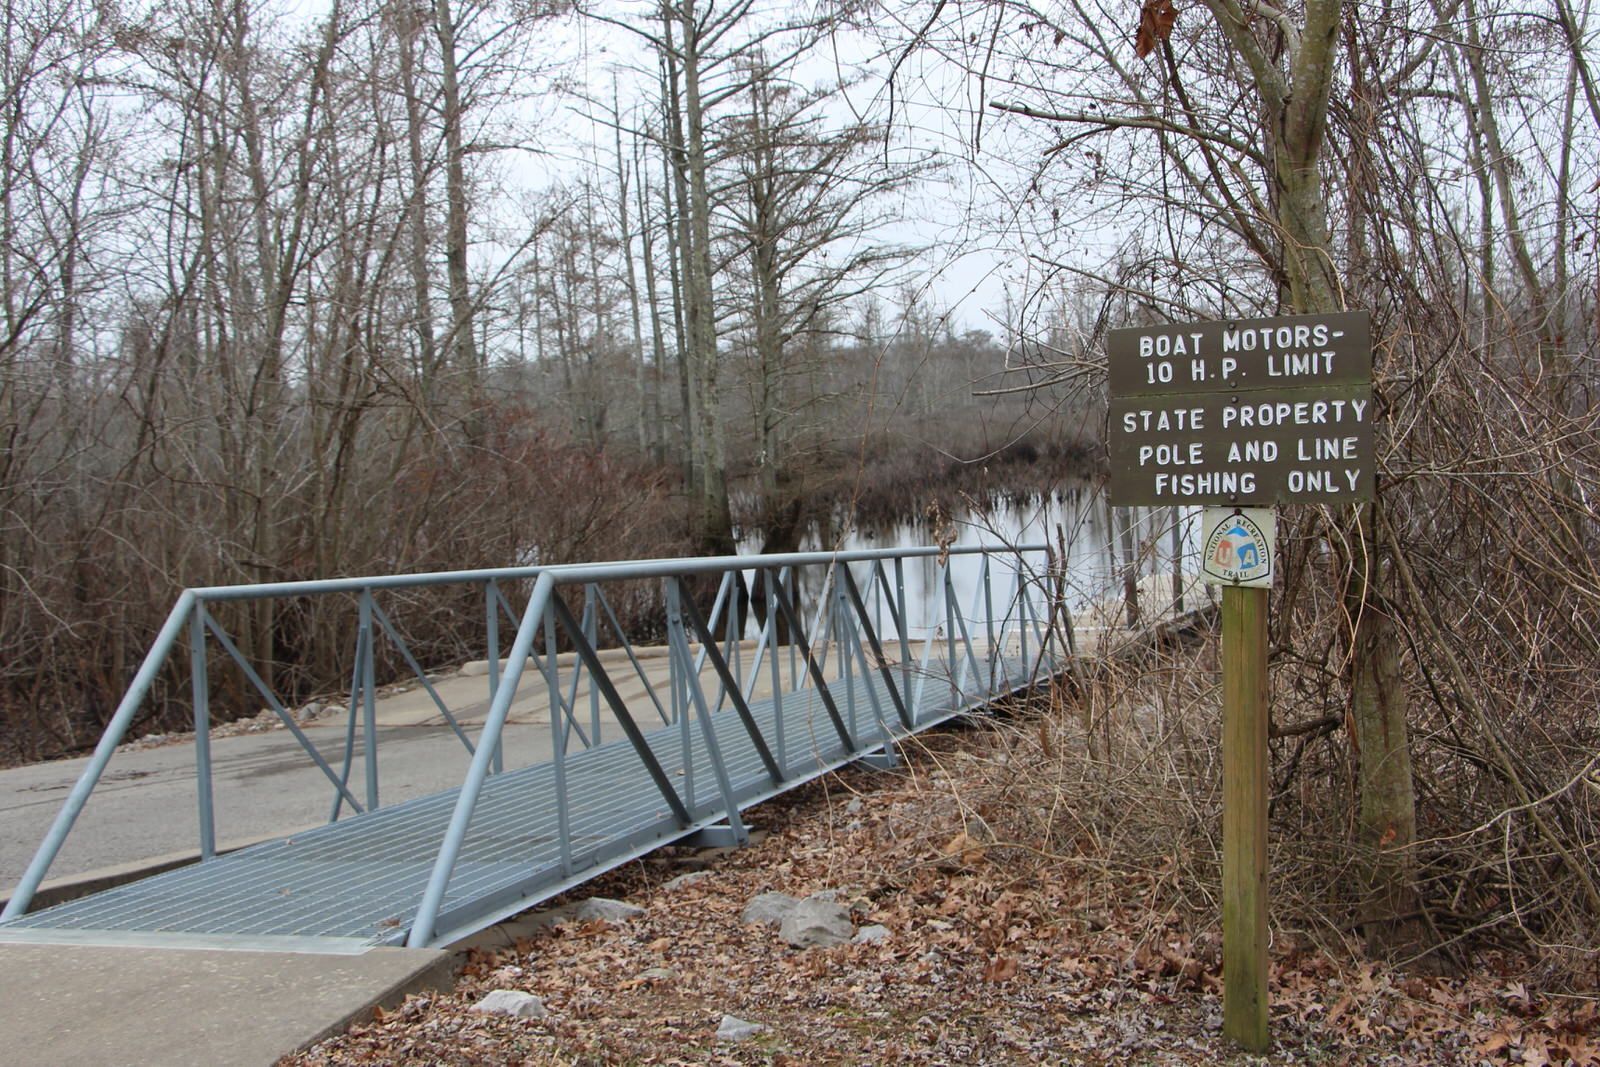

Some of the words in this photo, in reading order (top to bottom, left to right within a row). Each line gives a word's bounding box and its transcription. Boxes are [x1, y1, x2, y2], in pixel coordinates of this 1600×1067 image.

[1139, 333, 1203, 357] BOAT
[1223, 324, 1344, 352] MOTORS-
[1147, 362, 1172, 384] 10
[1268, 351, 1336, 377] LIMIT
[1124, 408, 1204, 433] STATE
[1222, 399, 1367, 429] PROPERTY
[1139, 443, 1203, 466] POLE
[1228, 440, 1278, 463] AND
[1298, 437, 1358, 461] LINE
[1155, 472, 1255, 495] FISHING
[1288, 468, 1360, 493] ONLY
[1208, 523, 1230, 560] NATIONAL
[1236, 519, 1266, 564] RECREATION
